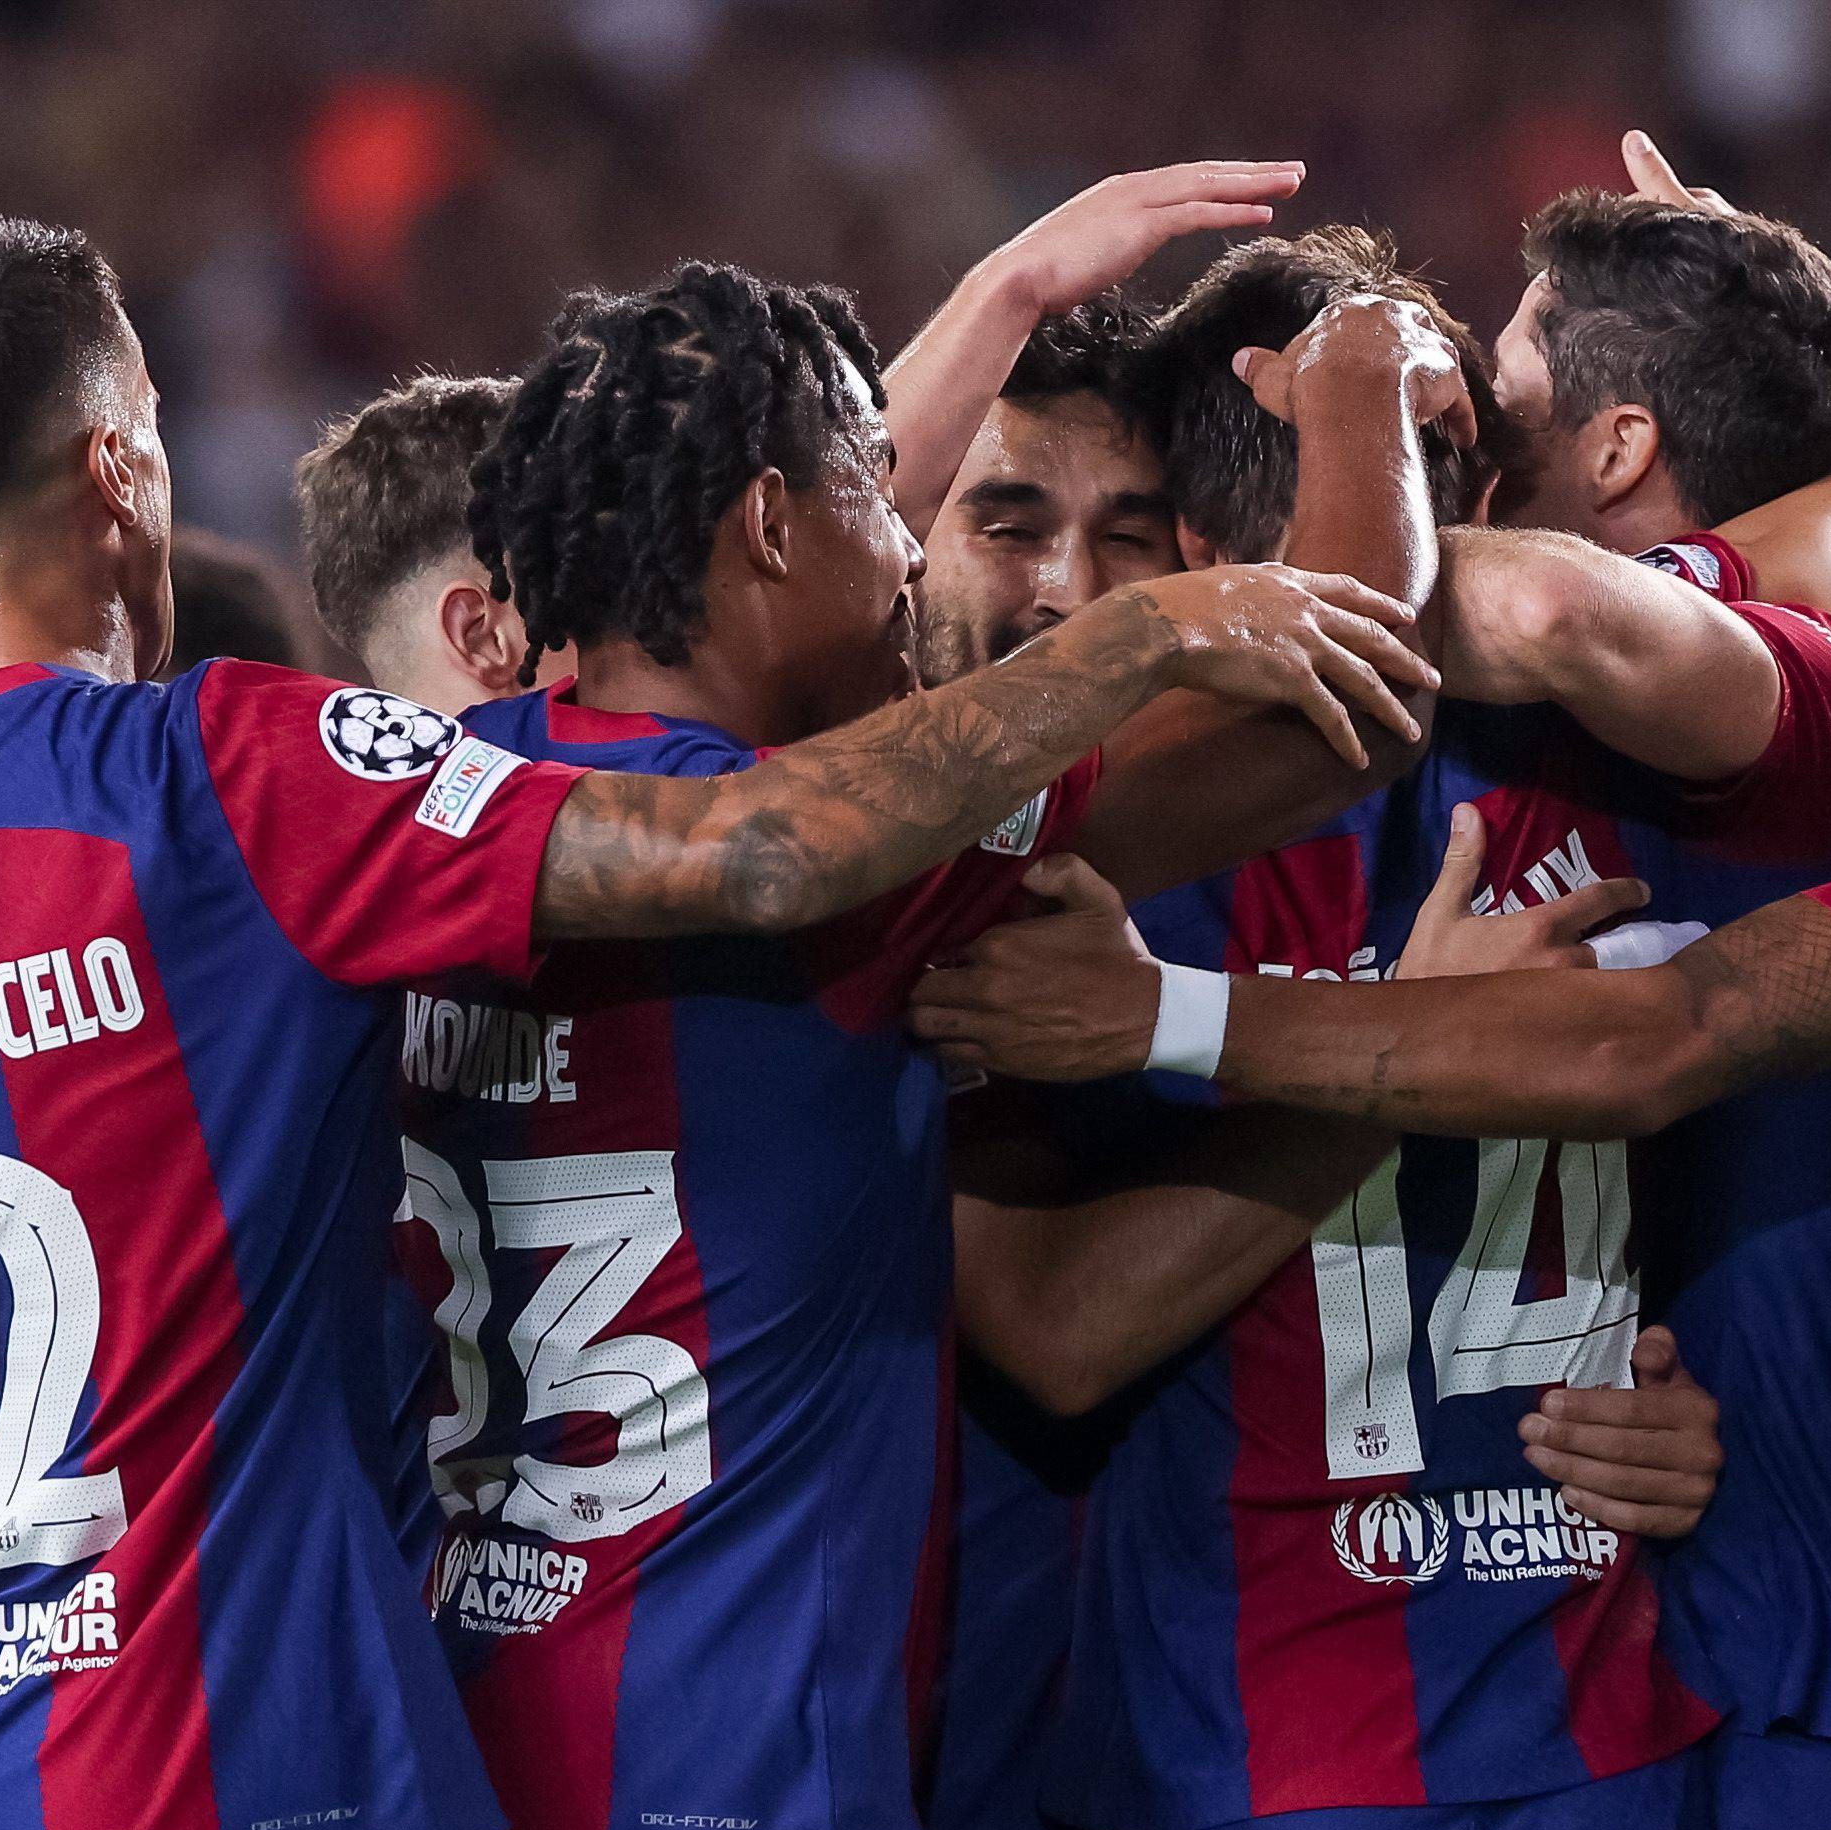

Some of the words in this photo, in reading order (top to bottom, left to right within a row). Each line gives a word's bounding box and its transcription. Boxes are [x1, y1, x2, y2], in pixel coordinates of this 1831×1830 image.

[364, 706, 415, 741] 5
[421, 783, 447, 820] UEFA
[1311, 1133, 1641, 1480] 14
[392, 1135, 713, 1543] 23
[1453, 1488, 1598, 1528] UNHC
[469, 1538, 588, 1595] UNHCR
[1462, 1525, 1618, 1567] ACNUR
[1465, 1567, 1489, 1581] The
[1491, 1568, 1514, 1581] UN
[1516, 1564, 1577, 1582] Refugee
[458, 1576, 572, 1623] ACNUR
